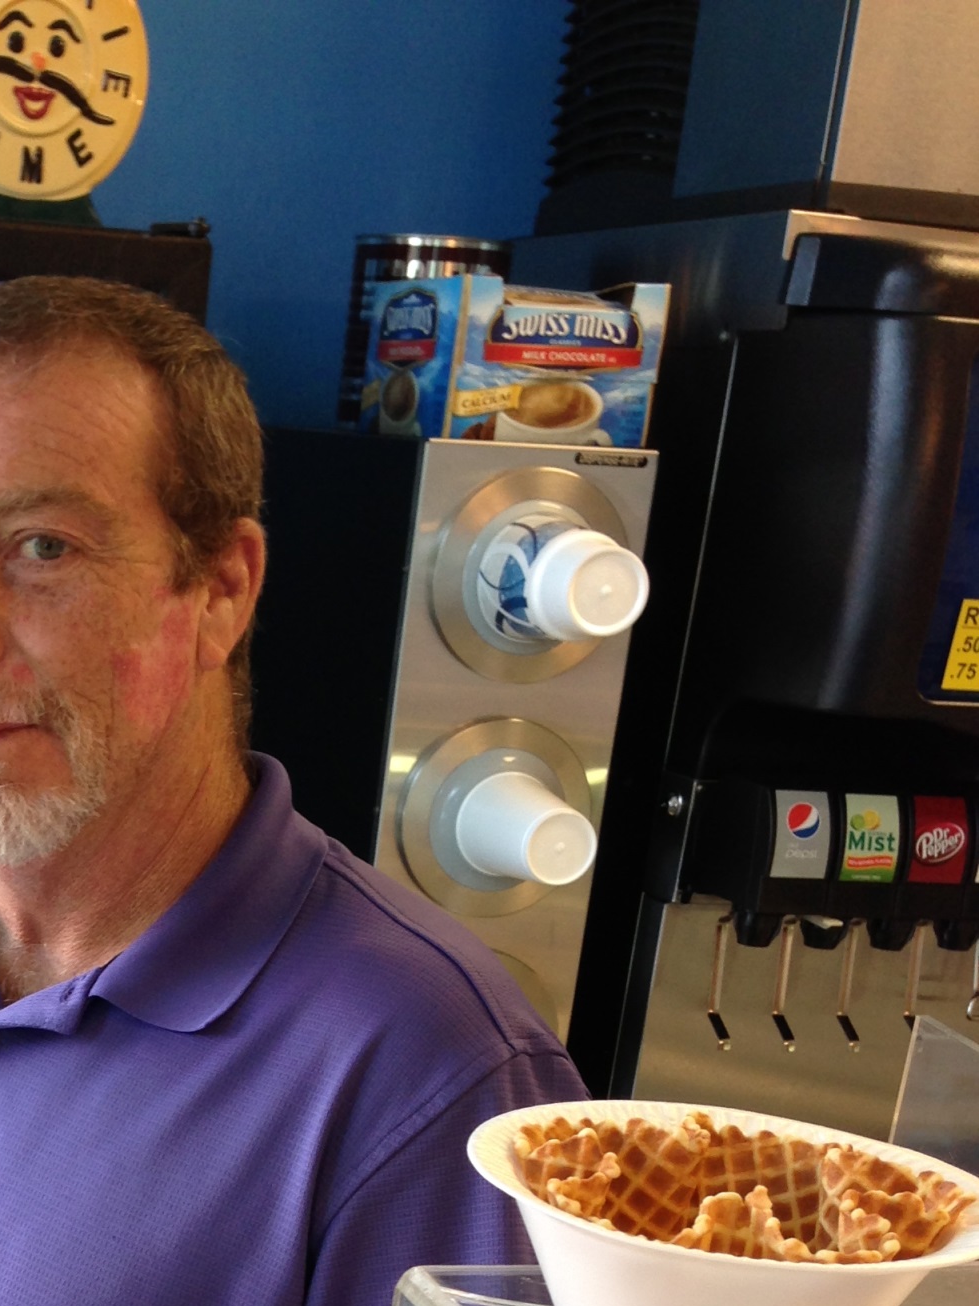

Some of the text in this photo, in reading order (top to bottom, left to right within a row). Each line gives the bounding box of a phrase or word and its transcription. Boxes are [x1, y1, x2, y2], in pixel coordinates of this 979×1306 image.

[522, 351, 547, 361] MILK
[548, 351, 606, 363] CHOCOLATE
[847, 830, 896, 853] Mist
[933, 827, 950, 841] Dr
[921, 831, 961, 859] Pepper
